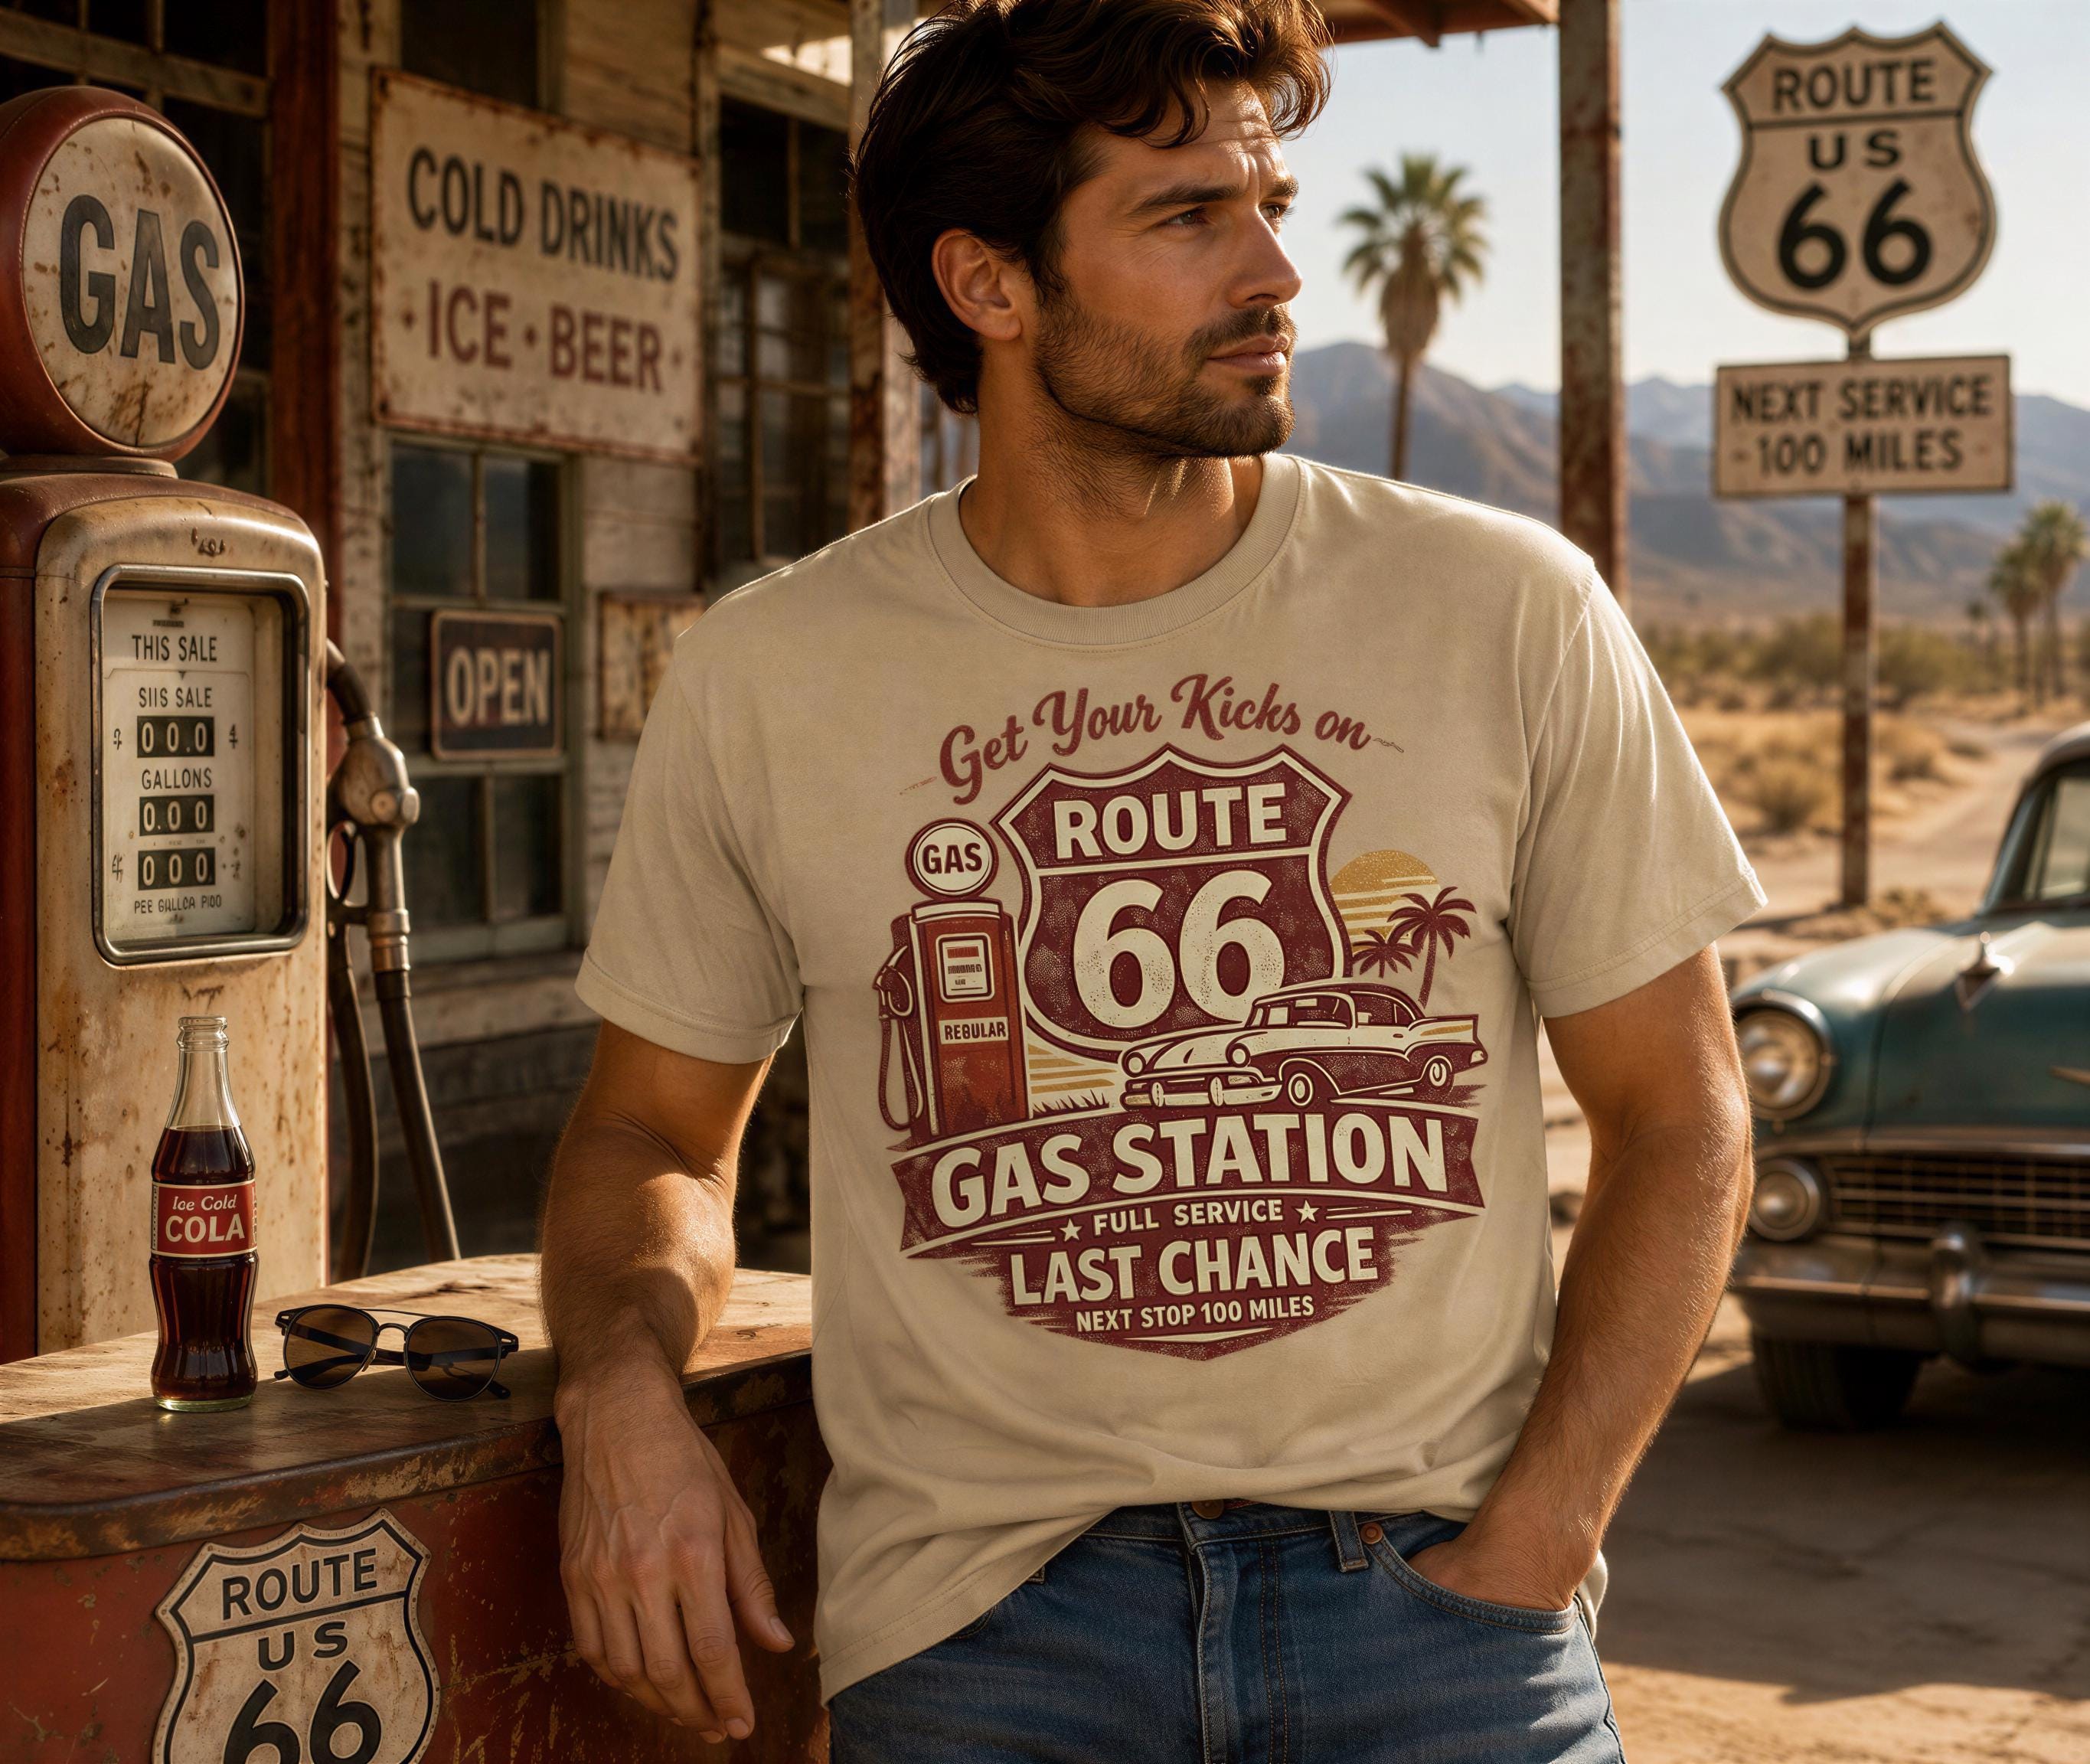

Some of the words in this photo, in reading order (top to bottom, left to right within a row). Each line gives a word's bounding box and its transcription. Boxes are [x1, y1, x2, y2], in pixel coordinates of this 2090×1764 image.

[1772, 58, 1936, 113] ROUTE
[1808, 129, 1902, 172] US
[408, 145, 524, 247] COLD
[540, 179, 678, 283] DRINKS
[1777, 178, 1932, 292] 66
[60, 194, 220, 370] GAS
[428, 278, 512, 370] ICE
[550, 303, 663, 394] BEER
[1732, 381, 1822, 423] NEXT
[1840, 375, 1991, 420] SERVICE
[1759, 432, 1827, 476] 100
[1843, 429, 1964, 472] MILES
[132, 635, 170, 661] THIS
[178, 635, 217, 662] SALE
[176, 687, 212, 707] SALE
[446, 645, 550, 727] OPEN
[939, 715, 1028, 805] Get
[1032, 688, 1162, 756] Your
[1171, 673, 1301, 741] Kicks
[1314, 710, 1372, 750] on
[142, 768, 212, 790] GALLONS
[1053, 782, 1287, 860] ROUTE
[922, 842, 982, 874] GAS
[1073, 870, 1285, 1028] 66
[932, 1133, 1090, 1227] GAS
[1112, 1113, 1448, 1193] STATION
[165, 1214, 245, 1243] COLA
[172, 1196, 194, 1210] Ice
[201, 1194, 237, 1210] Cold
[1093, 1207, 1159, 1236] FULL
[1174, 1200, 1283, 1227] SERVICE
[1011, 1246, 1141, 1305] LAST
[1158, 1227, 1378, 1296] CHANCE
[1076, 1308, 1132, 1332] NEXT
[1141, 1302, 1195, 1328] STOP
[1202, 1299, 1243, 1324] 100
[1249, 1295, 1314, 1320] MILES
[223, 1548, 377, 1620] ROUTE
[258, 1621, 348, 1671] US
[224, 1659, 381, 1764] 66
